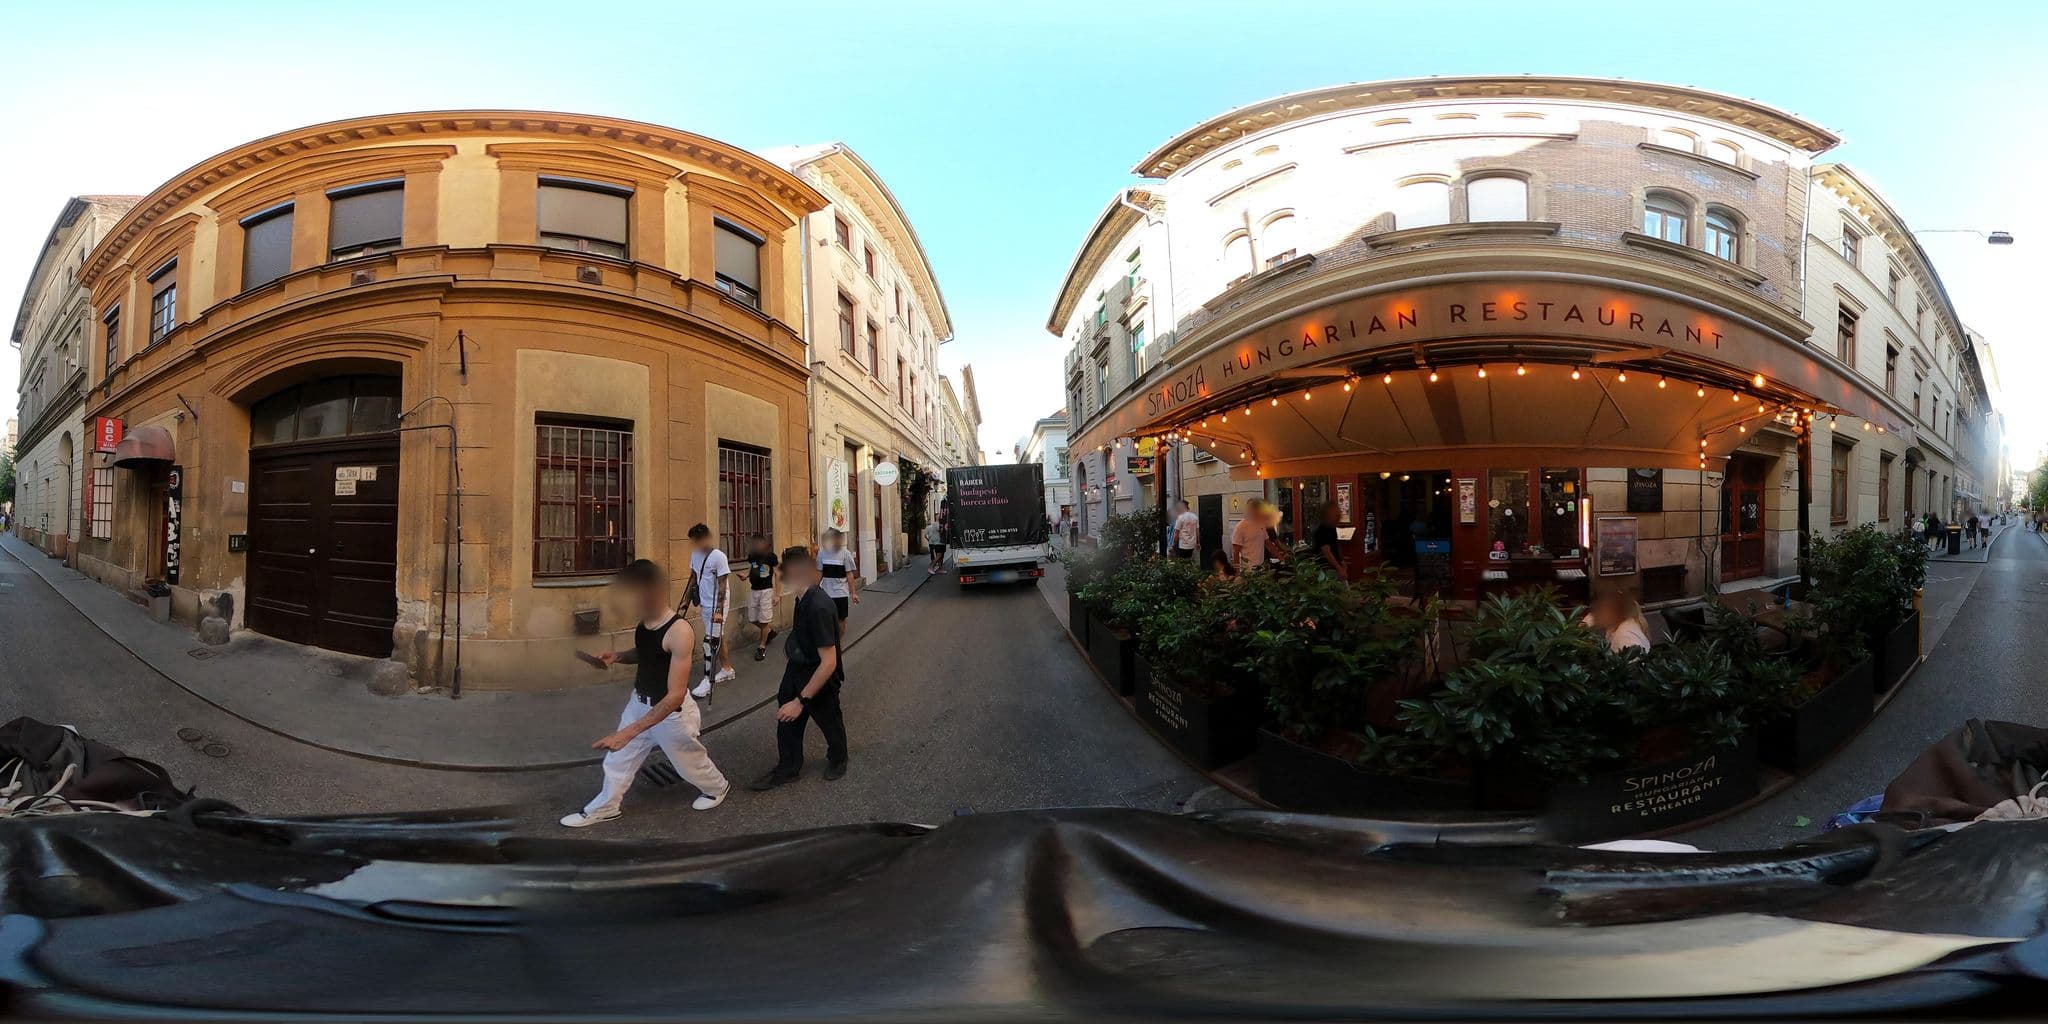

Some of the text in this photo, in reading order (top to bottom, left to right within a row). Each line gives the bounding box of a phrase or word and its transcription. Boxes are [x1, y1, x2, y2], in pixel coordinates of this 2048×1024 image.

[1148, 302, 1723, 416] SPINOZA HUNGARIAN RESTAURANT
[105, 419, 114, 441] ABC
[960, 487, 998, 497] budapesti
[1623, 755, 1716, 792] SPINOZA
[1611, 776, 1722, 814] RESTAURANT
[1635, 776, 1704, 799] HUNGARIAN
[1652, 795, 1701, 813] THEATER
